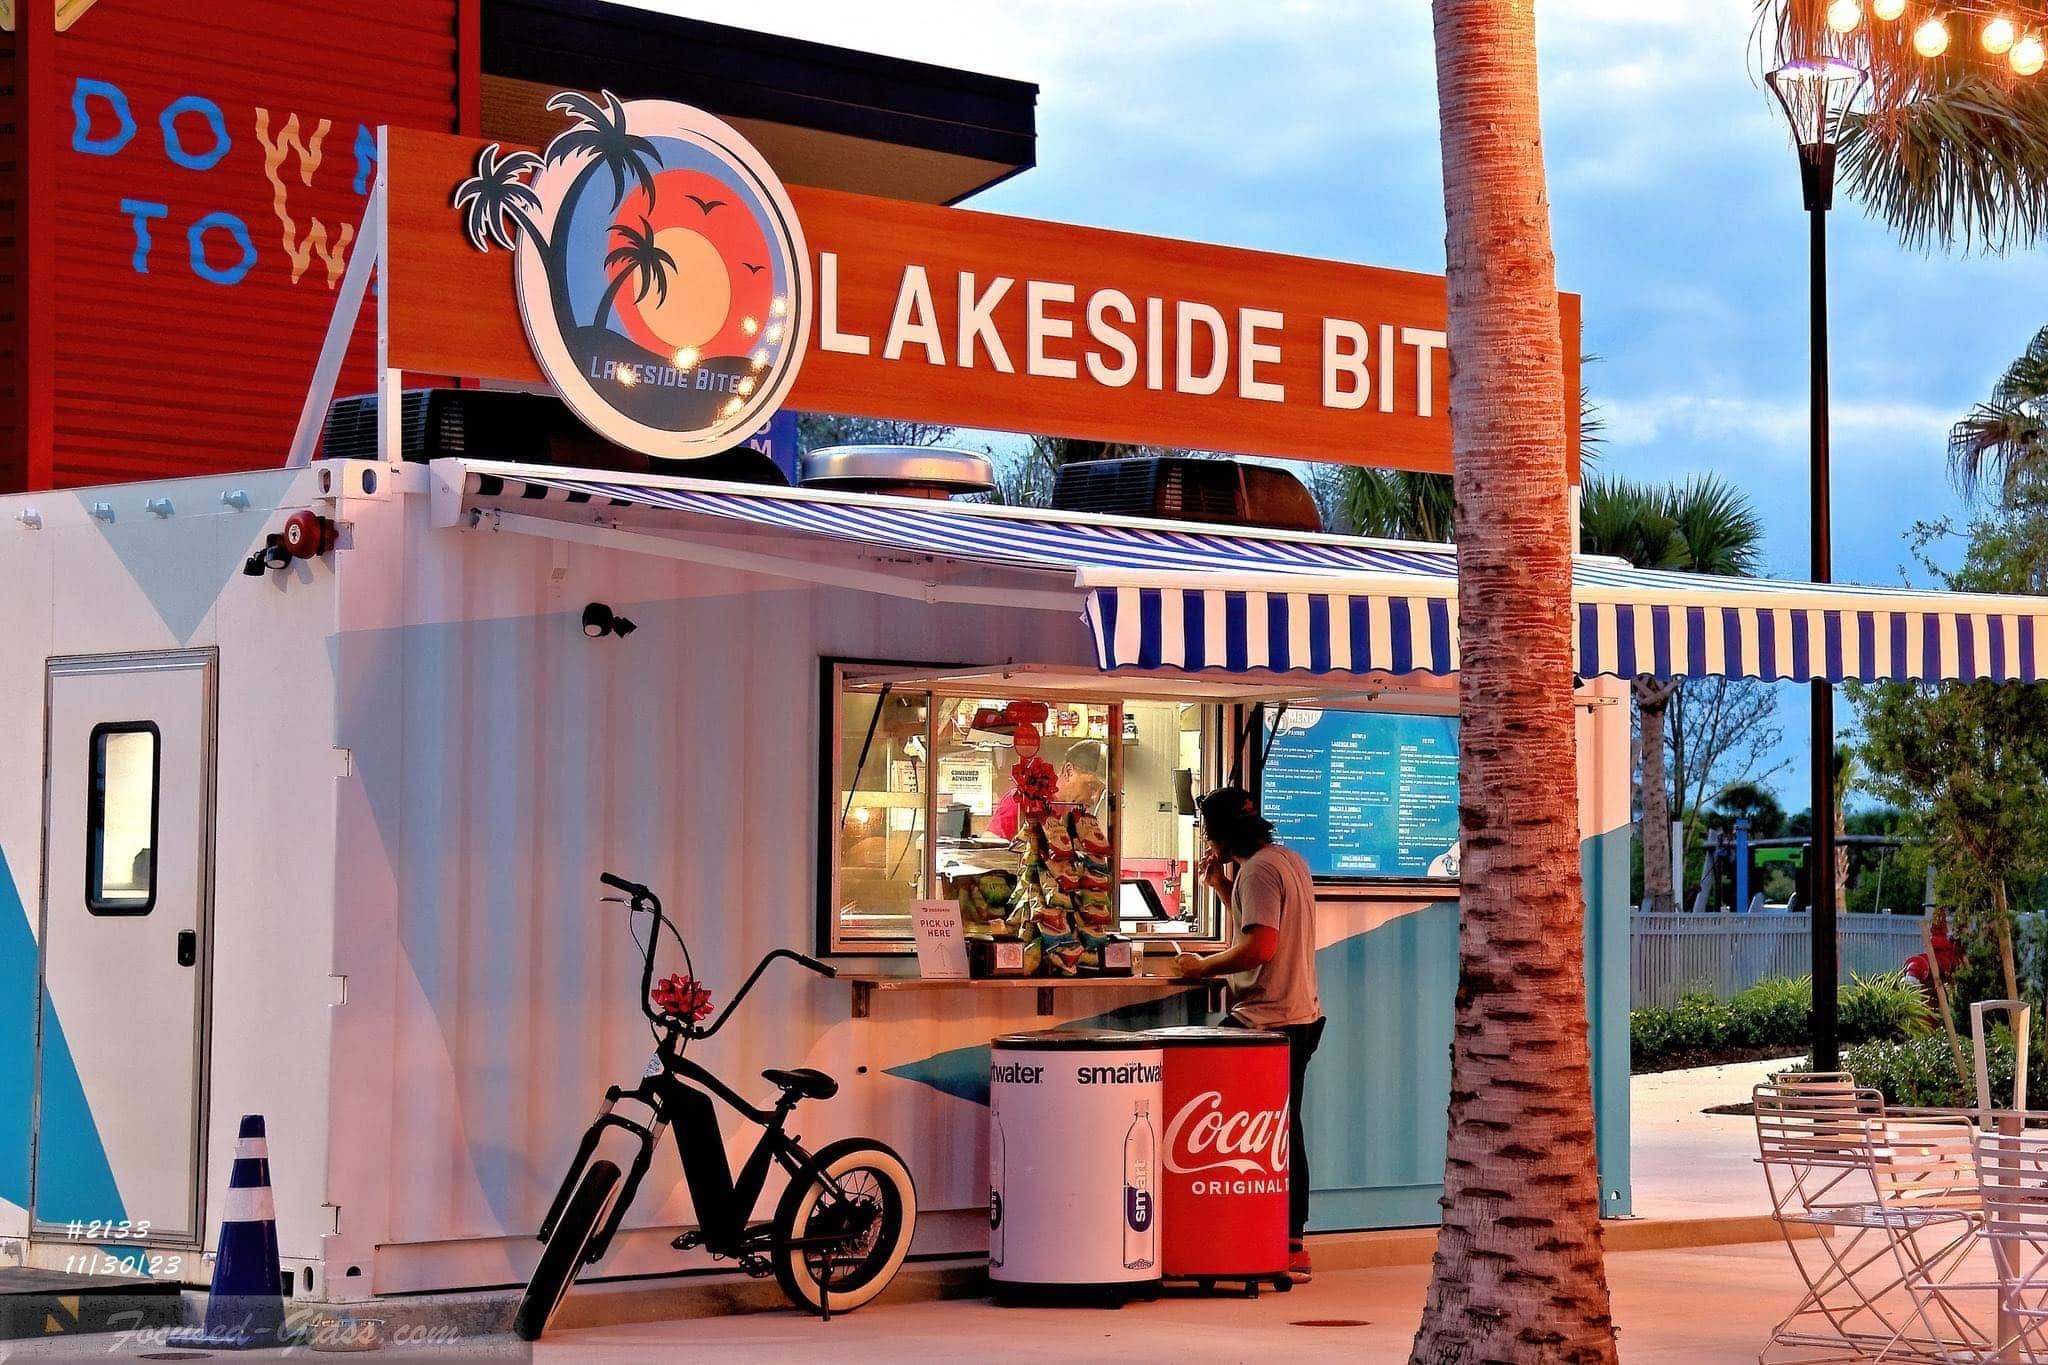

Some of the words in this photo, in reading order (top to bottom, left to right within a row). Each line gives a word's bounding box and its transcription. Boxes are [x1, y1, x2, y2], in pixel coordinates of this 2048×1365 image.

[121, 197, 356, 290] TOW
[819, 252, 1285, 403] LAKESIDE
[1322, 316, 1448, 418] BIT
[590, 356, 689, 388] LAESIDE
[695, 367, 754, 394] BITE
[920, 919, 941, 928] PICK
[943, 919, 955, 928] UP
[927, 929, 951, 937] HERE
[991, 1061, 1044, 1084] twater
[1162, 1091, 1289, 1174] Coca-C
[1191, 1179, 1282, 1195] ORIGINAL
